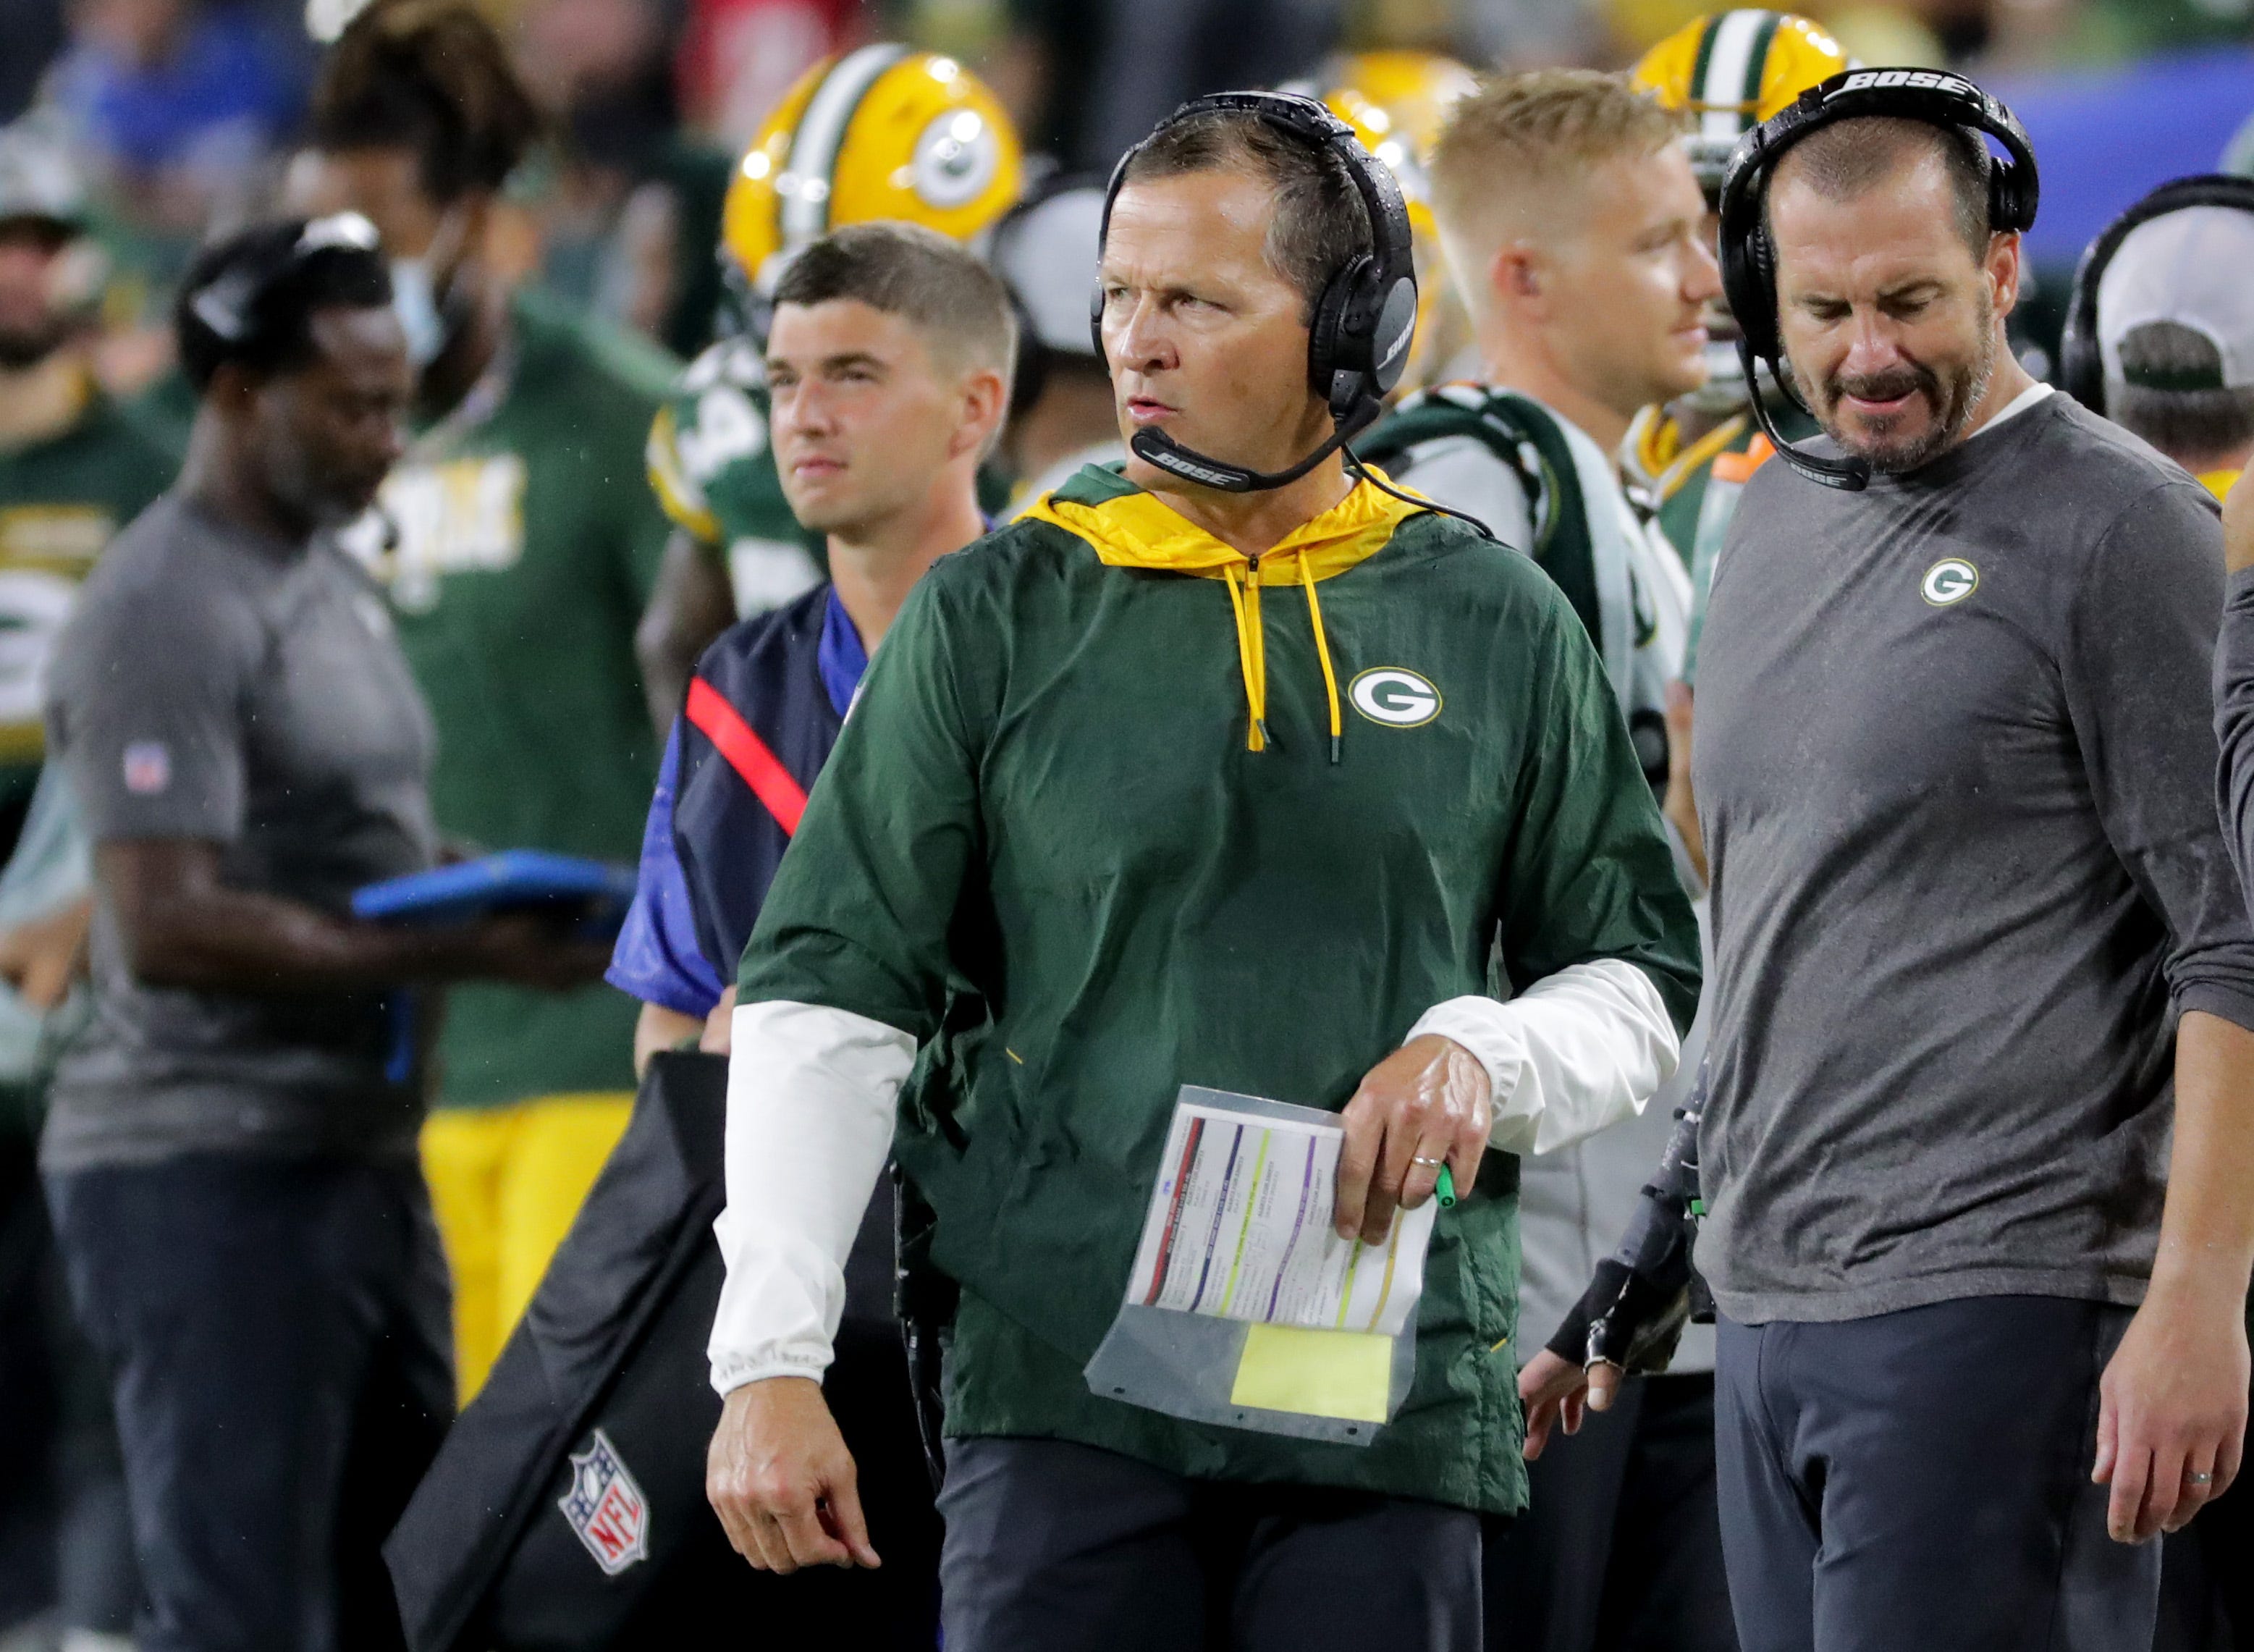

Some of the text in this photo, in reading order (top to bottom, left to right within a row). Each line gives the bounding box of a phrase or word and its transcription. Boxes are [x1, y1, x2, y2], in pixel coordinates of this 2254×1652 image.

[1823, 72, 1981, 103] BOSE
[1141, 450, 1242, 485] BOSE
[1924, 562, 1974, 602] G
[1354, 672, 1436, 722] G
[590, 1484, 641, 1560] NFL
